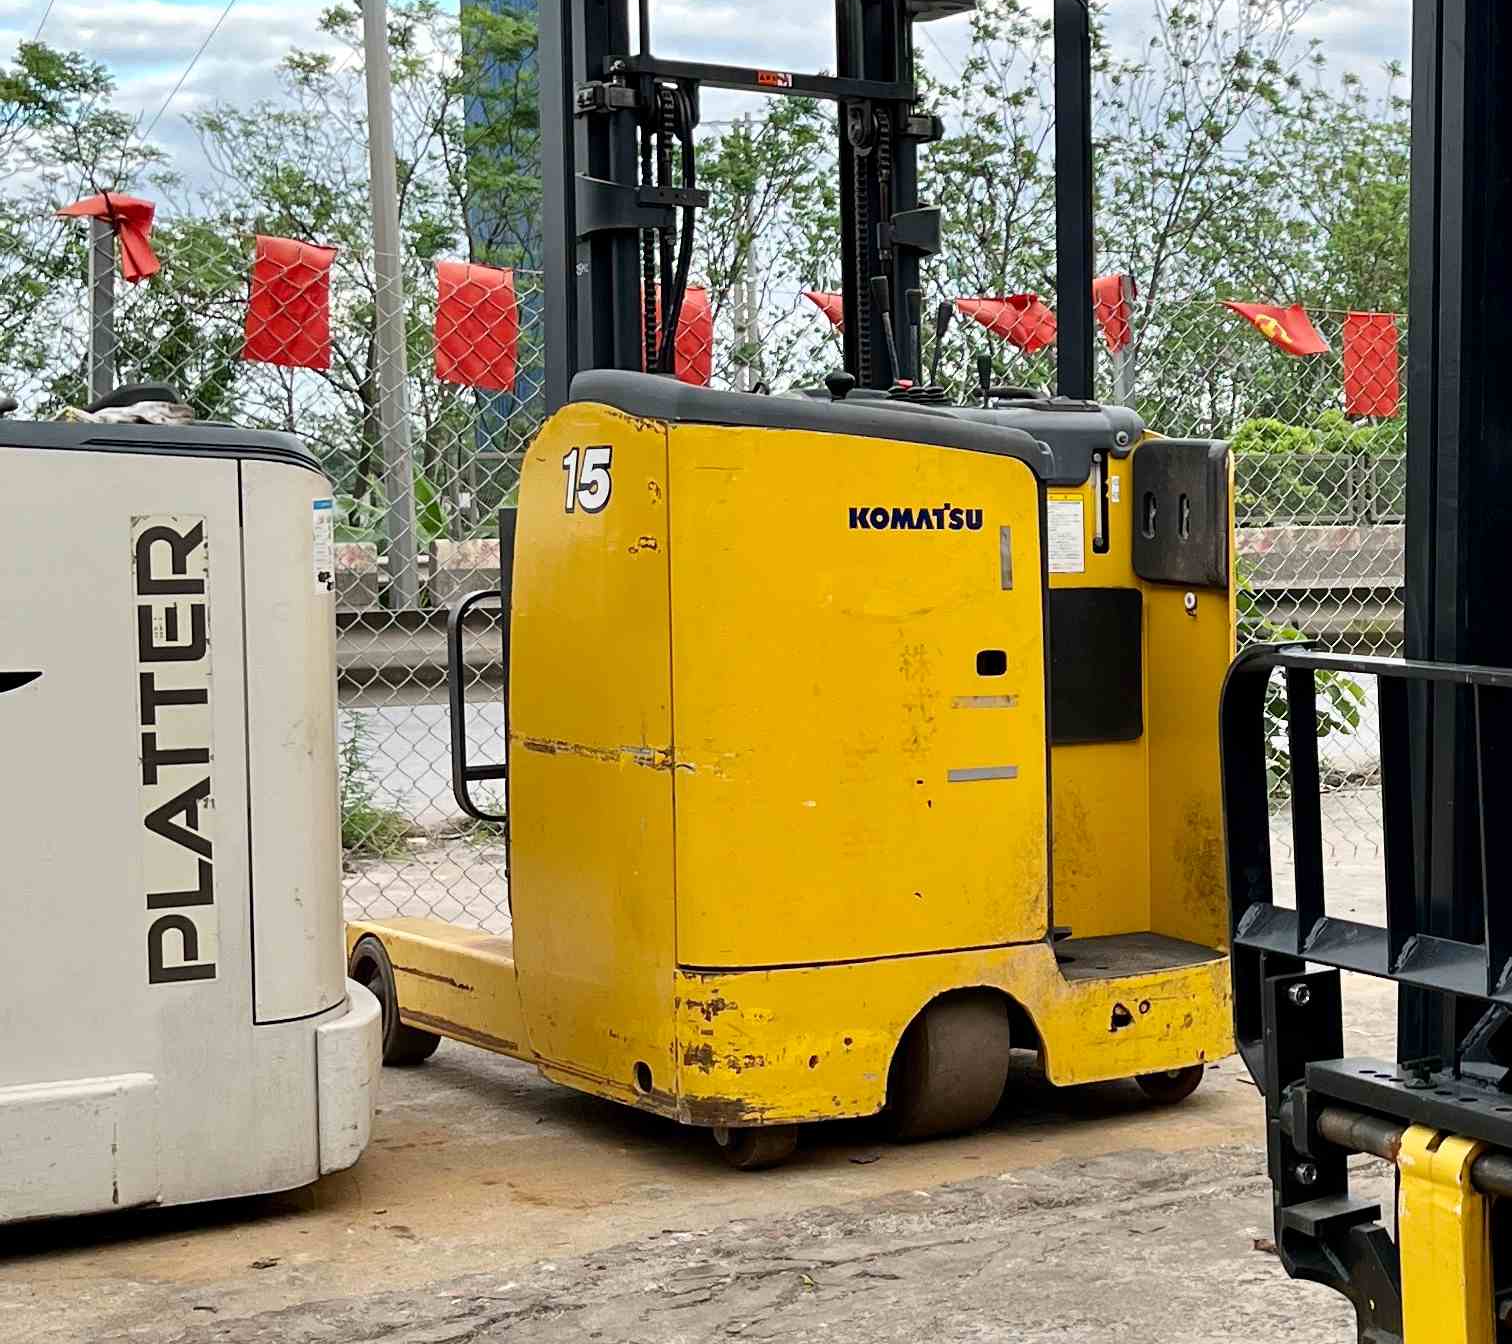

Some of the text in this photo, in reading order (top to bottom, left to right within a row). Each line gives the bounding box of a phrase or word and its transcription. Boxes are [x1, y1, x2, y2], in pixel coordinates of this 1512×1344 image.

[562, 445, 613, 514] 15
[849, 503, 983, 530] KOMATSU
[134, 521, 217, 986] PLATTER
